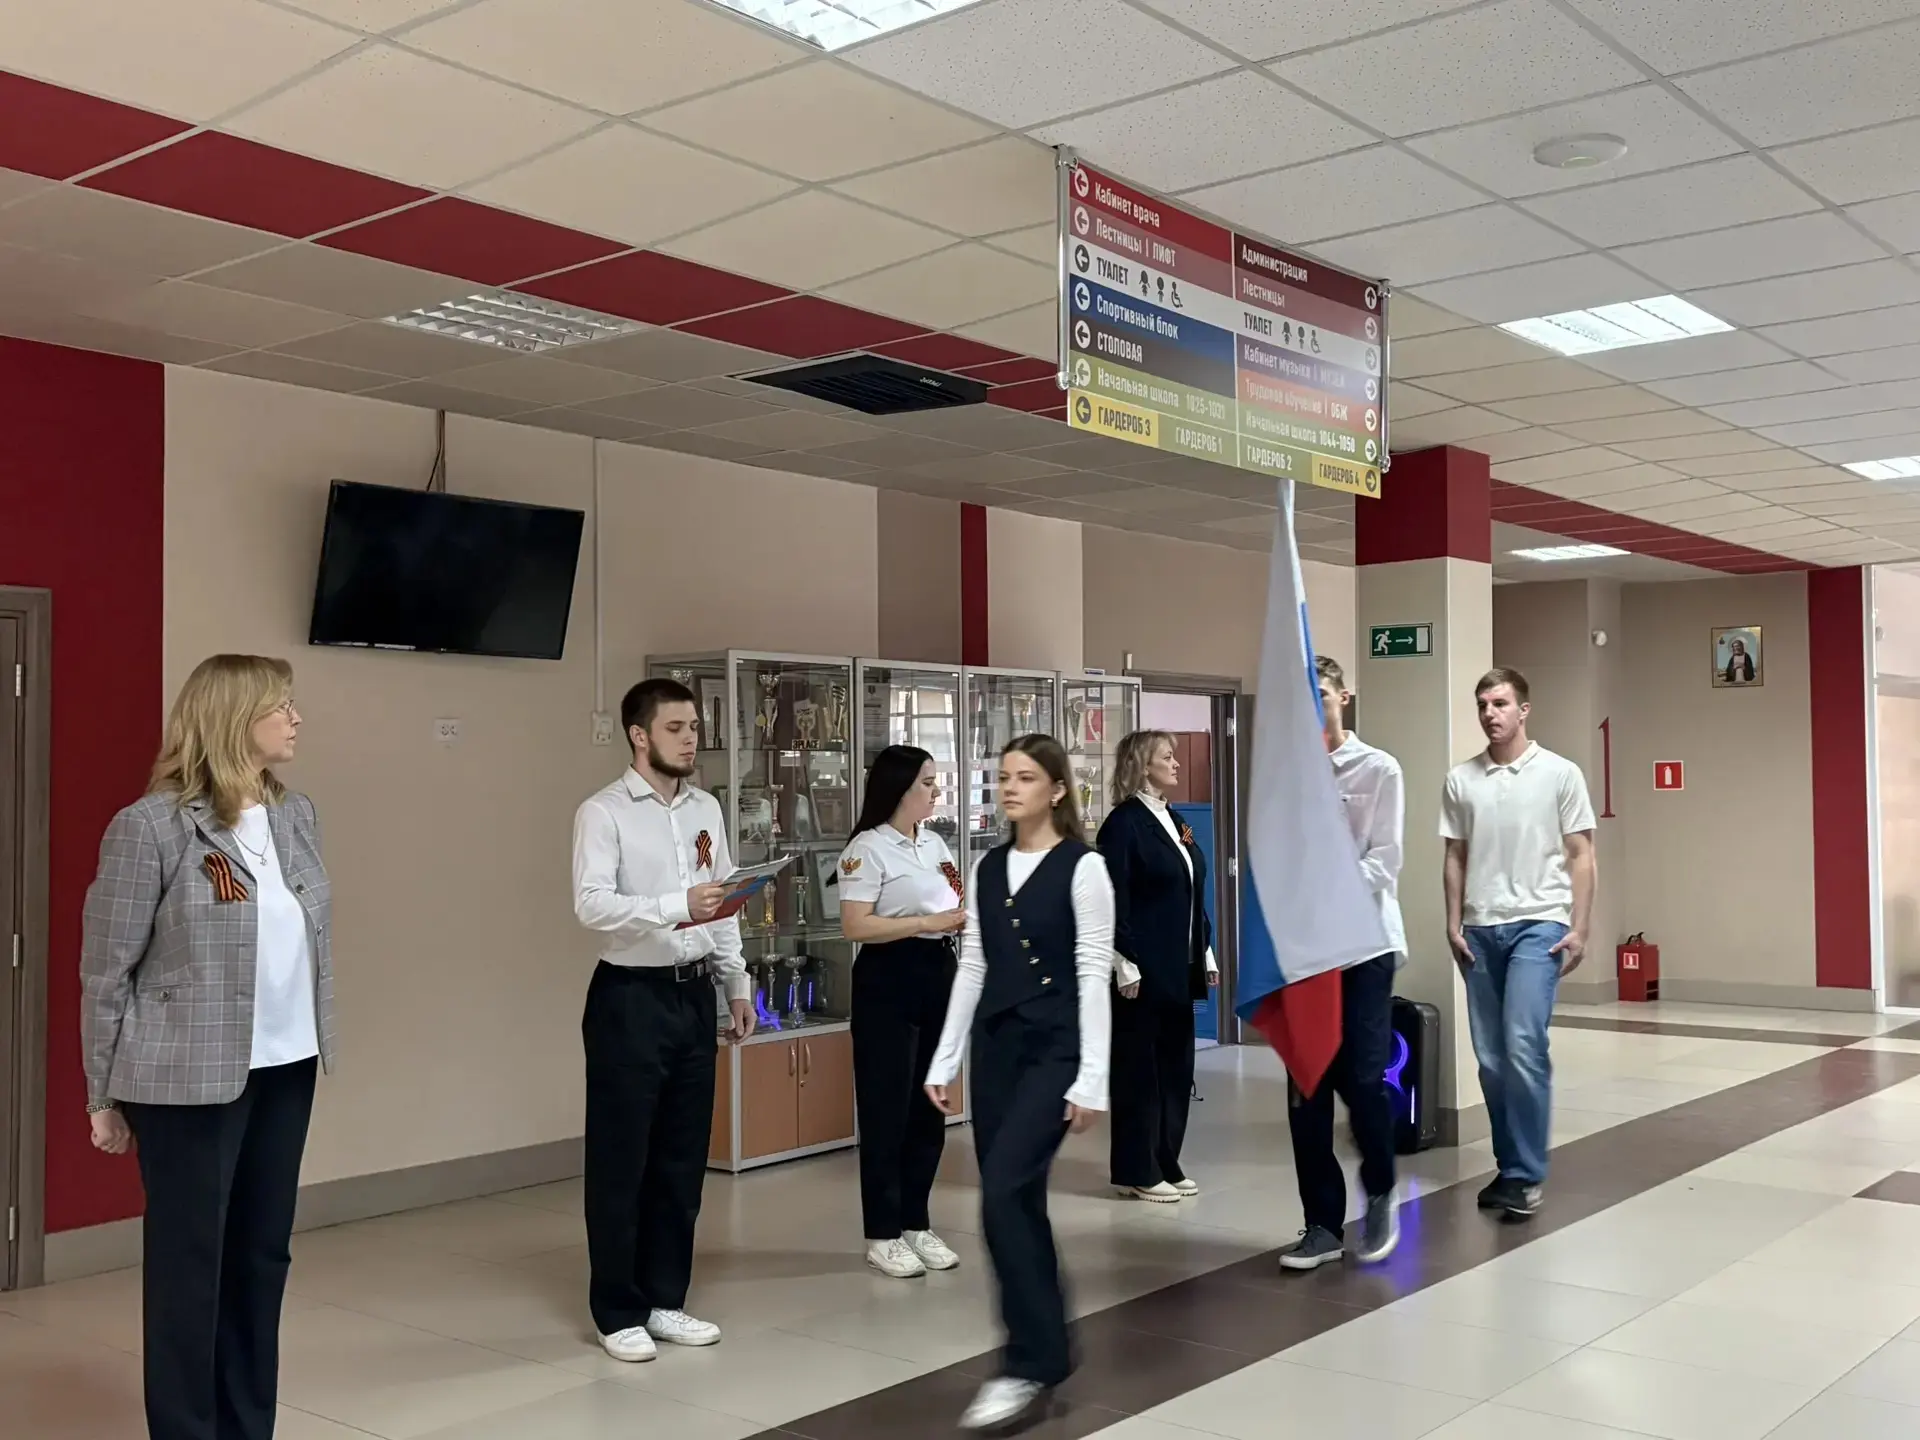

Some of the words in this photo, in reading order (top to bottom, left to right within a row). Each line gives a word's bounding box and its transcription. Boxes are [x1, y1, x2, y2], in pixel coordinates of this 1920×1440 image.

[1095, 182, 1132, 215] Кабинет
[1134, 206, 1160, 228] врача
[1096, 218, 1142, 254] Лестницы
[1097, 257, 1129, 286] ТУАЛЕТ
[1242, 244, 1308, 282] Администрация
[1243, 278, 1285, 308] Лестницы
[1097, 294, 1155, 332] Спортивный
[1156, 315, 1179, 340] блок
[1243, 312, 1273, 337] ТУАЛЕТ
[1097, 331, 1143, 364] СТОЛОВАЯ
[1244, 343, 1278, 370] Кабинет
[1098, 367, 1148, 398] Начальная
[1150, 386, 1179, 408] школа
[1098, 406, 1144, 436] ГАРДЕРОБ
[1145, 419, 1151, 437] 3
[1246, 410, 1290, 437] Начальная
[1291, 424, 1317, 444] школа
[1176, 426, 1217, 453] ГАРДЕРОБ
[1218, 437, 1223, 454] 1
[1247, 444, 1286, 469] ГАРДЕРОБ
[1286, 455, 1293, 471] 2
[1319, 463, 1353, 485] ГАРДЕРОБ
[1354, 471, 1360, 487] 4
